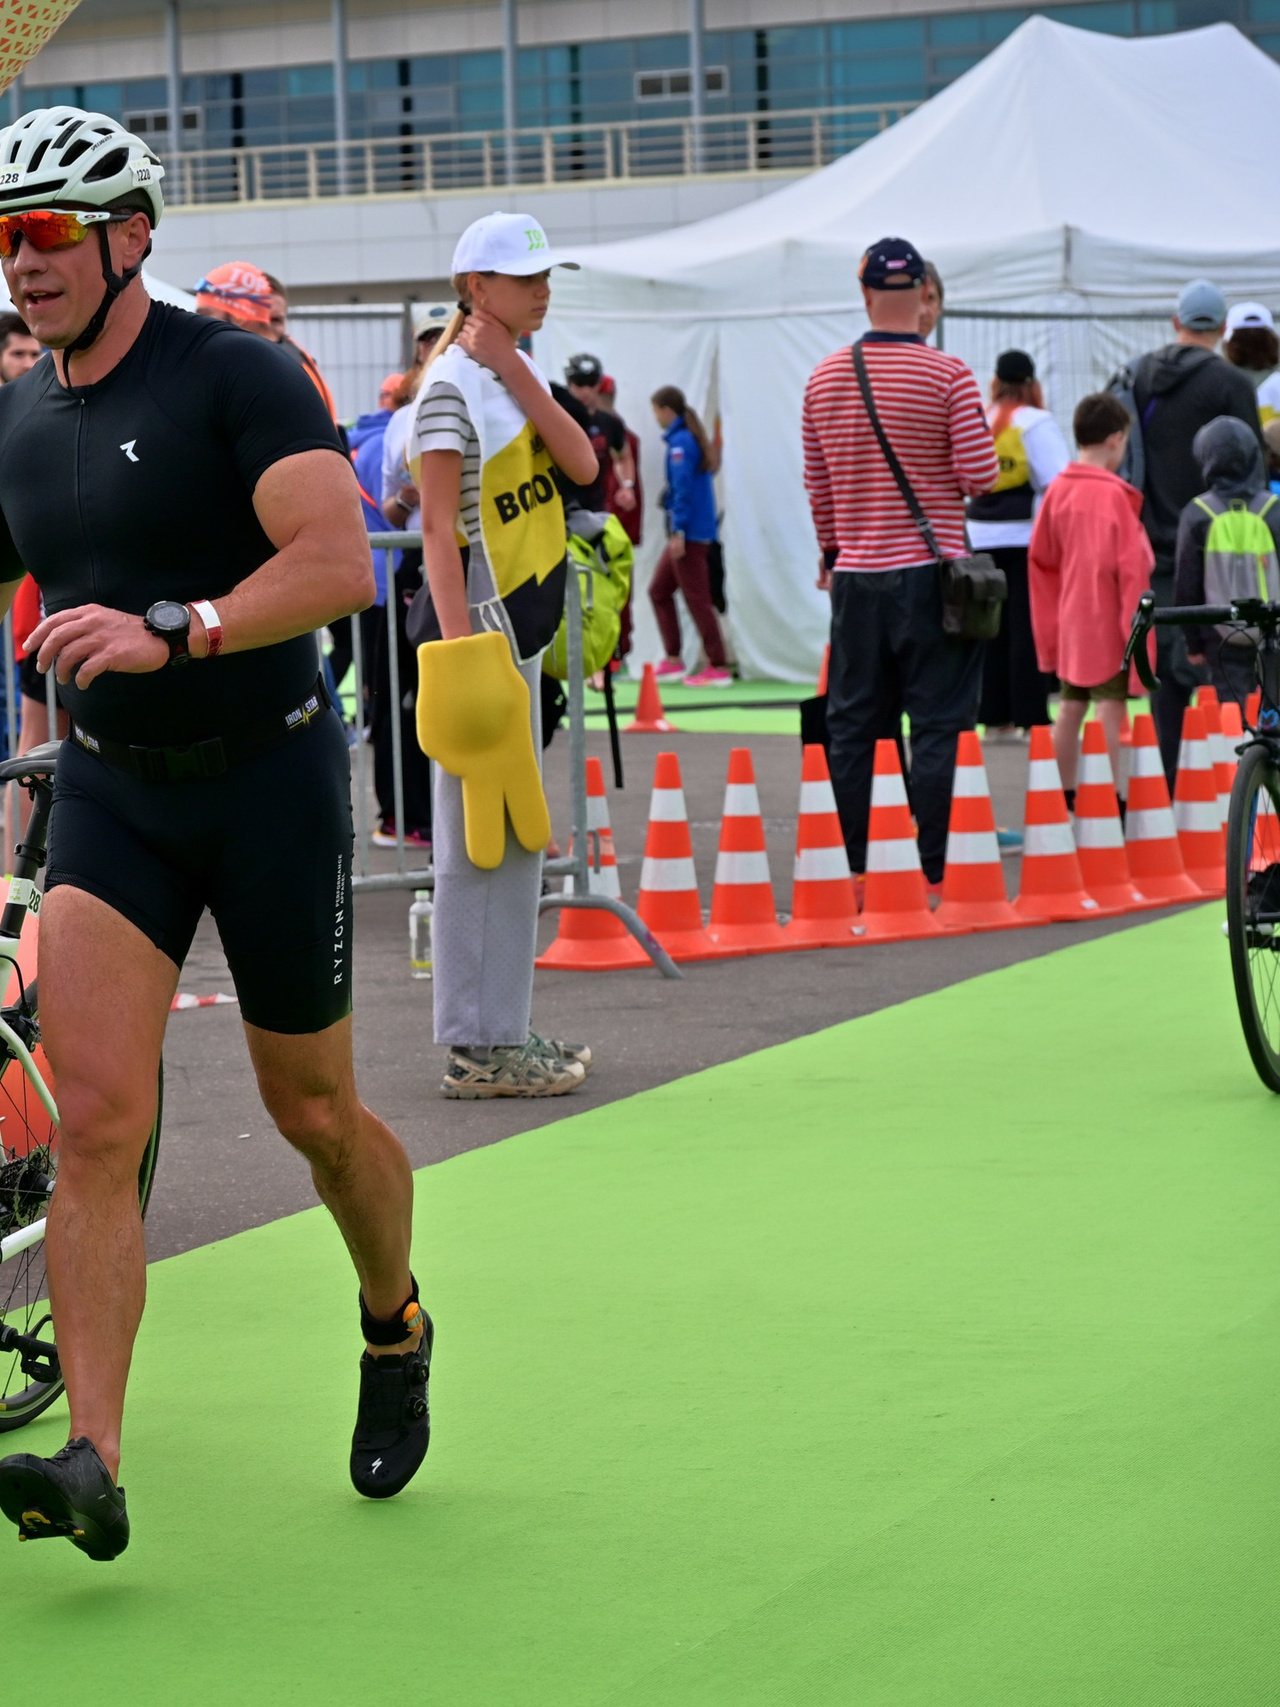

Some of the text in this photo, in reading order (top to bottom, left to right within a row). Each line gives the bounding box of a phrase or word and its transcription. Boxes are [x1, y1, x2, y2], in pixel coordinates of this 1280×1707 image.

[284, 695, 319, 726] IRON STAR
[333, 909, 344, 985] RYZON
